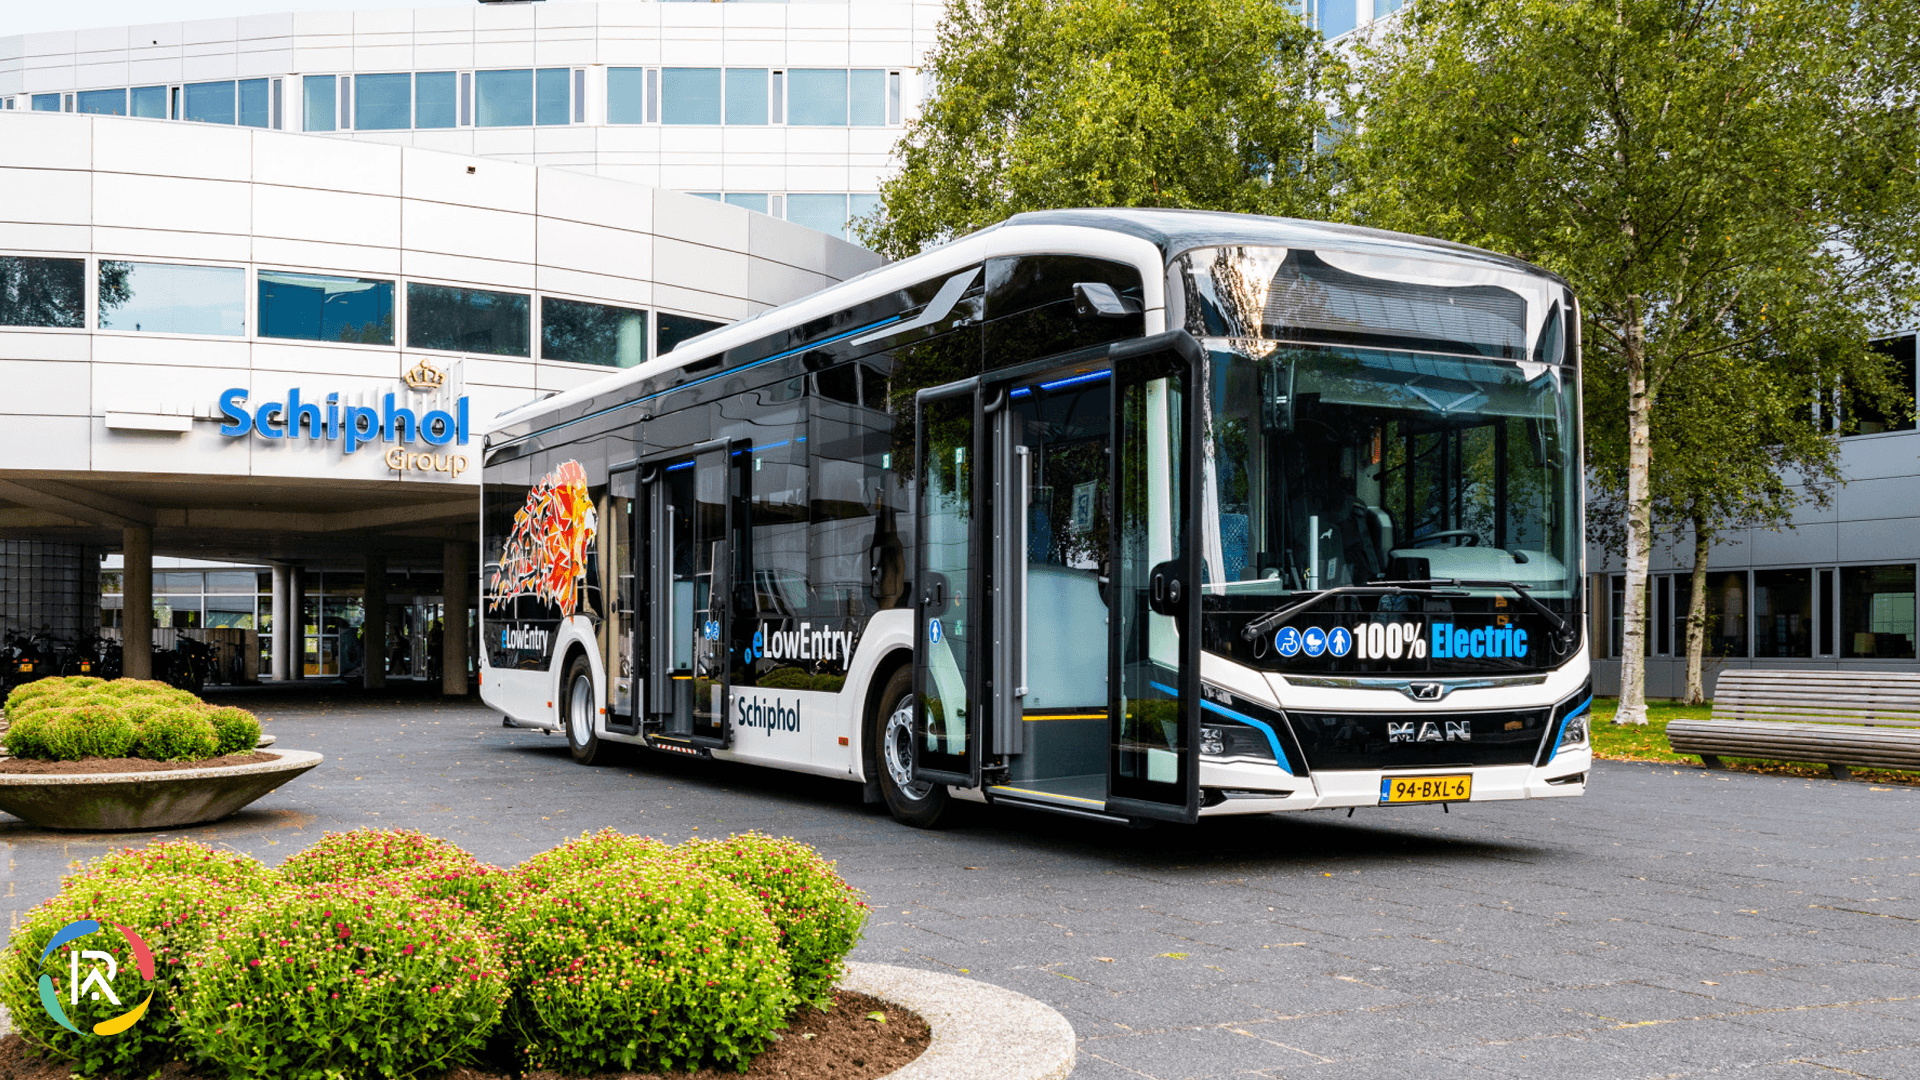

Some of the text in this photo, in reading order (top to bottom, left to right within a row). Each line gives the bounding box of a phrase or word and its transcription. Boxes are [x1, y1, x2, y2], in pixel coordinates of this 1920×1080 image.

[219, 387, 469, 454] Schiphol
[385, 446, 469, 478] Group
[501, 623, 549, 657] eLowEntry
[753, 622, 853, 671] eLowEntry
[1353, 622, 1528, 660] 100% Electric
[738, 695, 801, 737] Schiphol
[1388, 720, 1471, 743] MAN
[1396, 780, 1465, 799] 94-BXL-6
